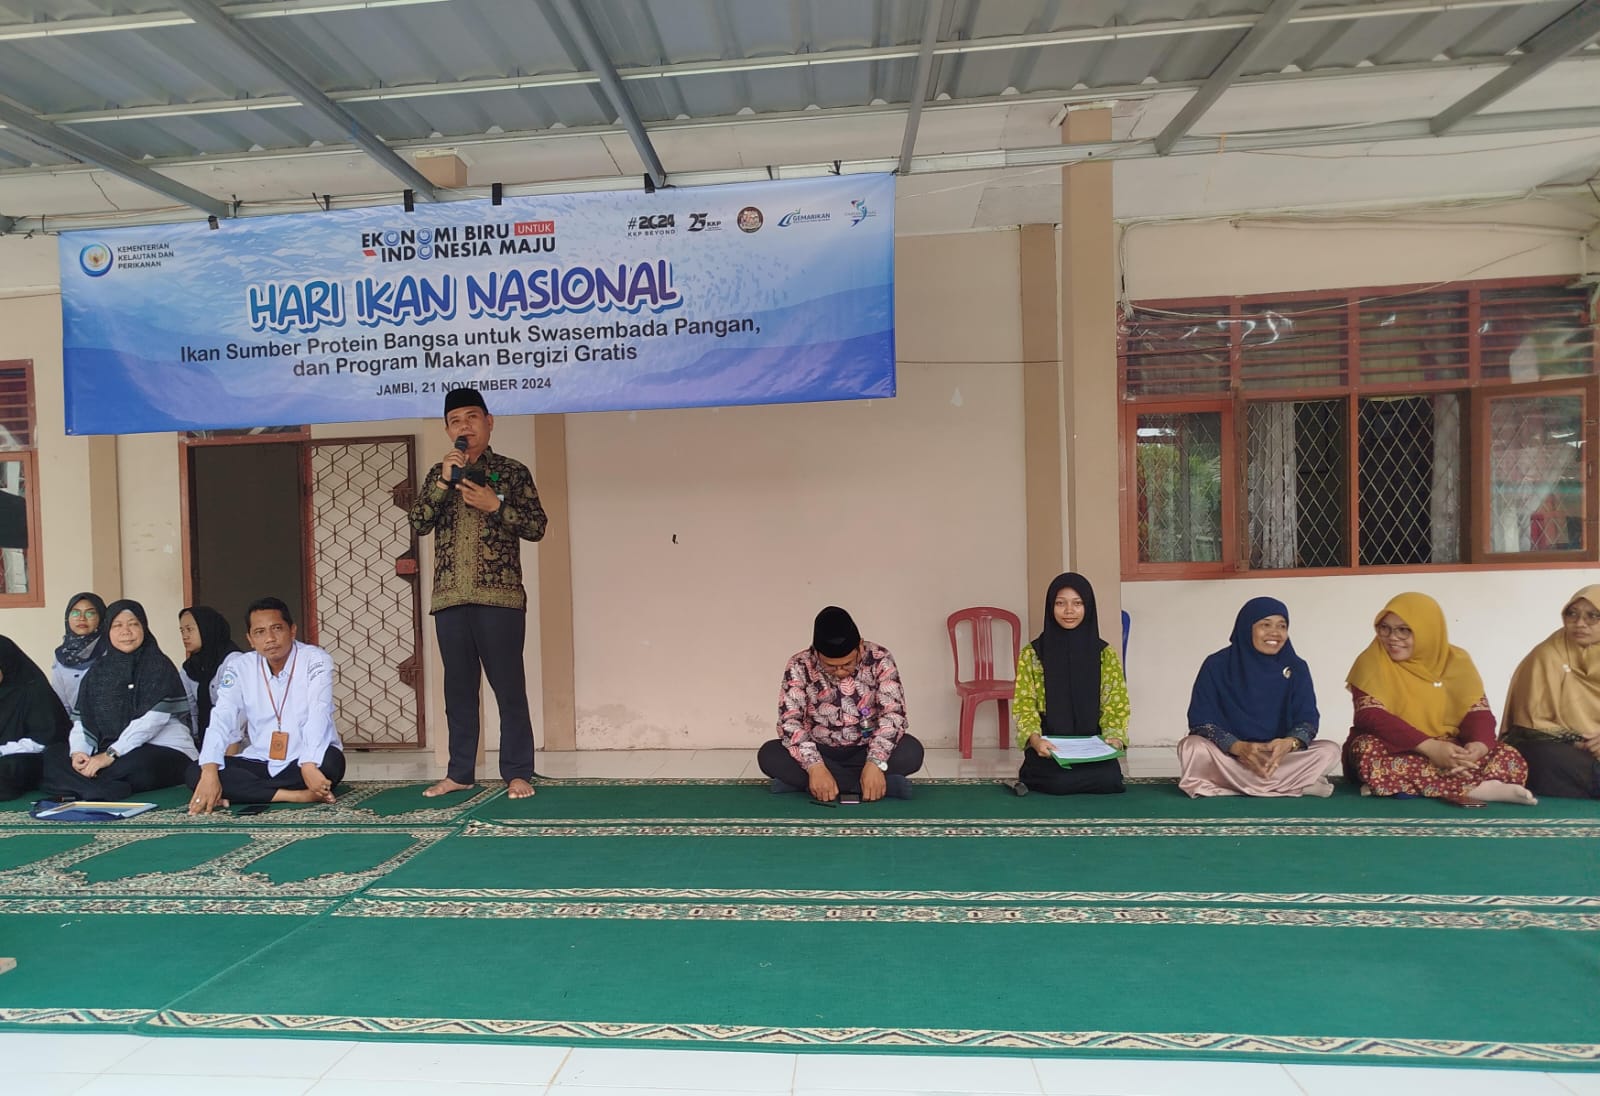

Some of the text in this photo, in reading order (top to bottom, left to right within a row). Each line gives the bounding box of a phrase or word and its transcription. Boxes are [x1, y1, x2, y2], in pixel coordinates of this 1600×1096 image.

[688, 212, 708, 232] 25
[792, 212, 831, 221] GEMARIKAN
[361, 223, 552, 248] EKONOMI BIRU UNTUK
[117, 243, 170, 253] KEMENTERIAN
[118, 250, 175, 261] KELAUTAN DAN
[381, 236, 556, 263] INDONESIA MAJU
[118, 260, 161, 269] PERIKANAN
[249, 259, 678, 328] HARI IKAN NASIONAL
[180, 317, 761, 363] Ikan Sumber Protein Bangsa untuk Swasembada Pangan,
[293, 343, 638, 377] dan Program Makan Bergizi Gratis
[376, 378, 552, 396] JAMBI, 21 NOVEMBER 2024
